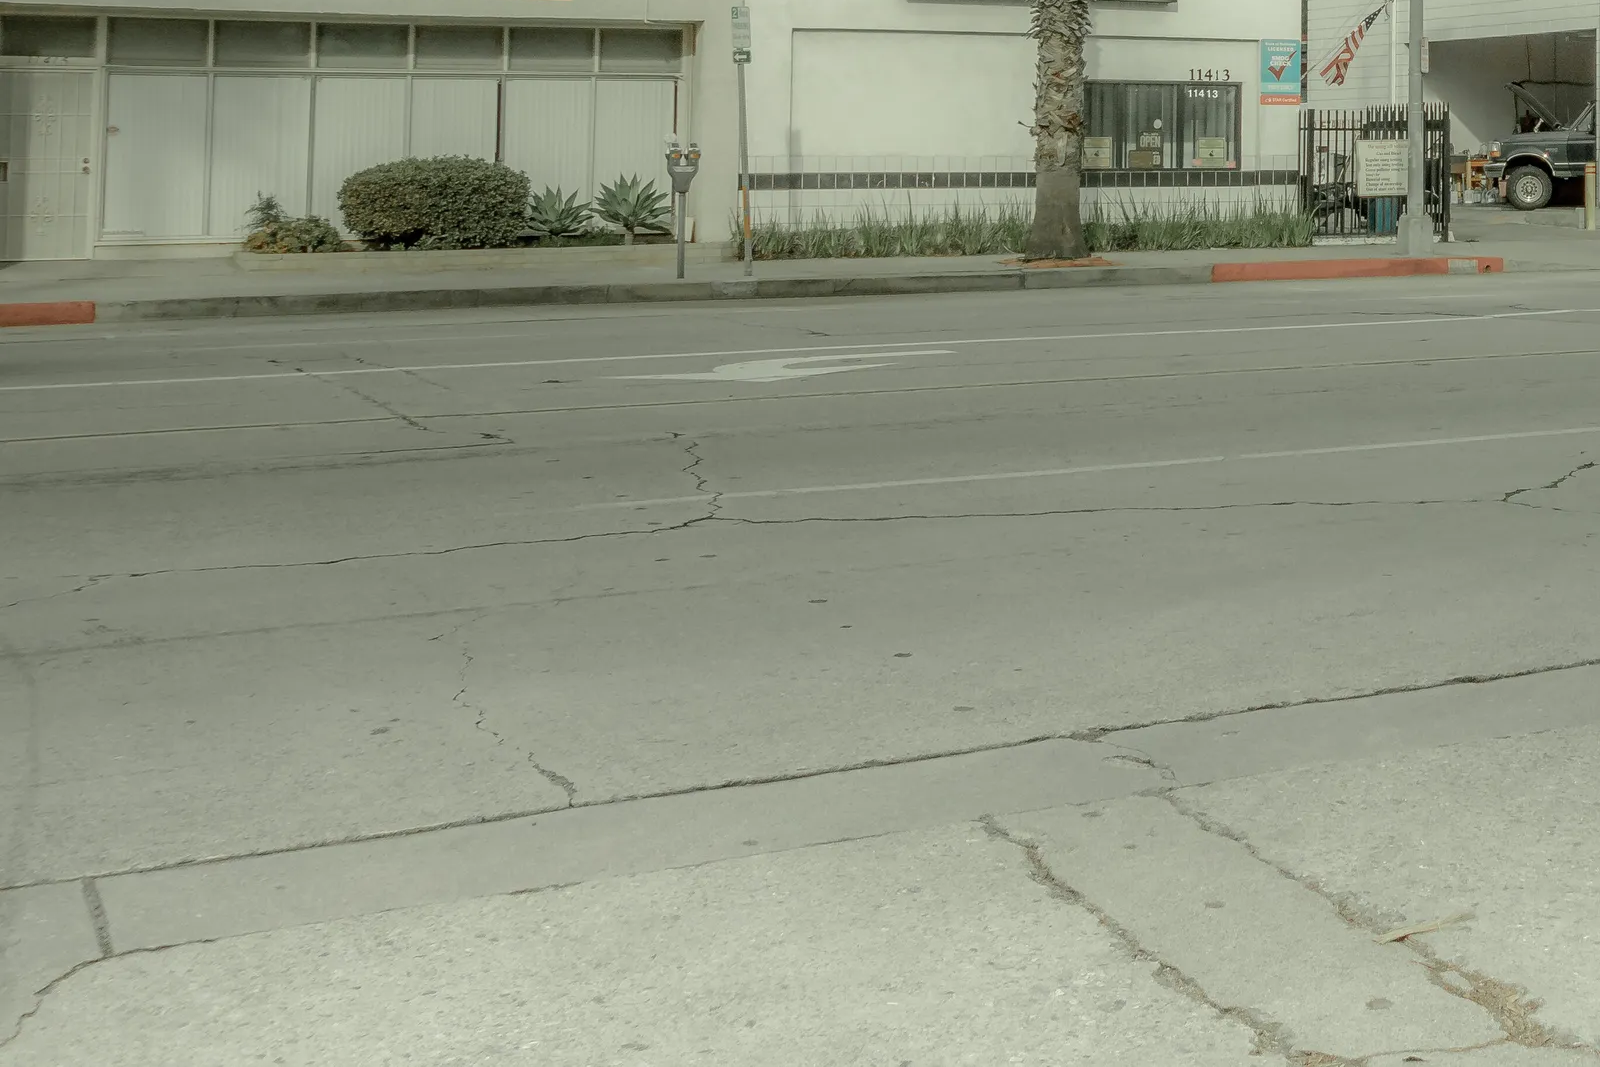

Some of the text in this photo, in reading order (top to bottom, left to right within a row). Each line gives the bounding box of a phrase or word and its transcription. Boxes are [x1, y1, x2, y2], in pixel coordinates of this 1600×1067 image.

[1189, 69, 1230, 81] 11413
[1187, 89, 1219, 99] 11413
[1139, 135, 1161, 149] OPEN
